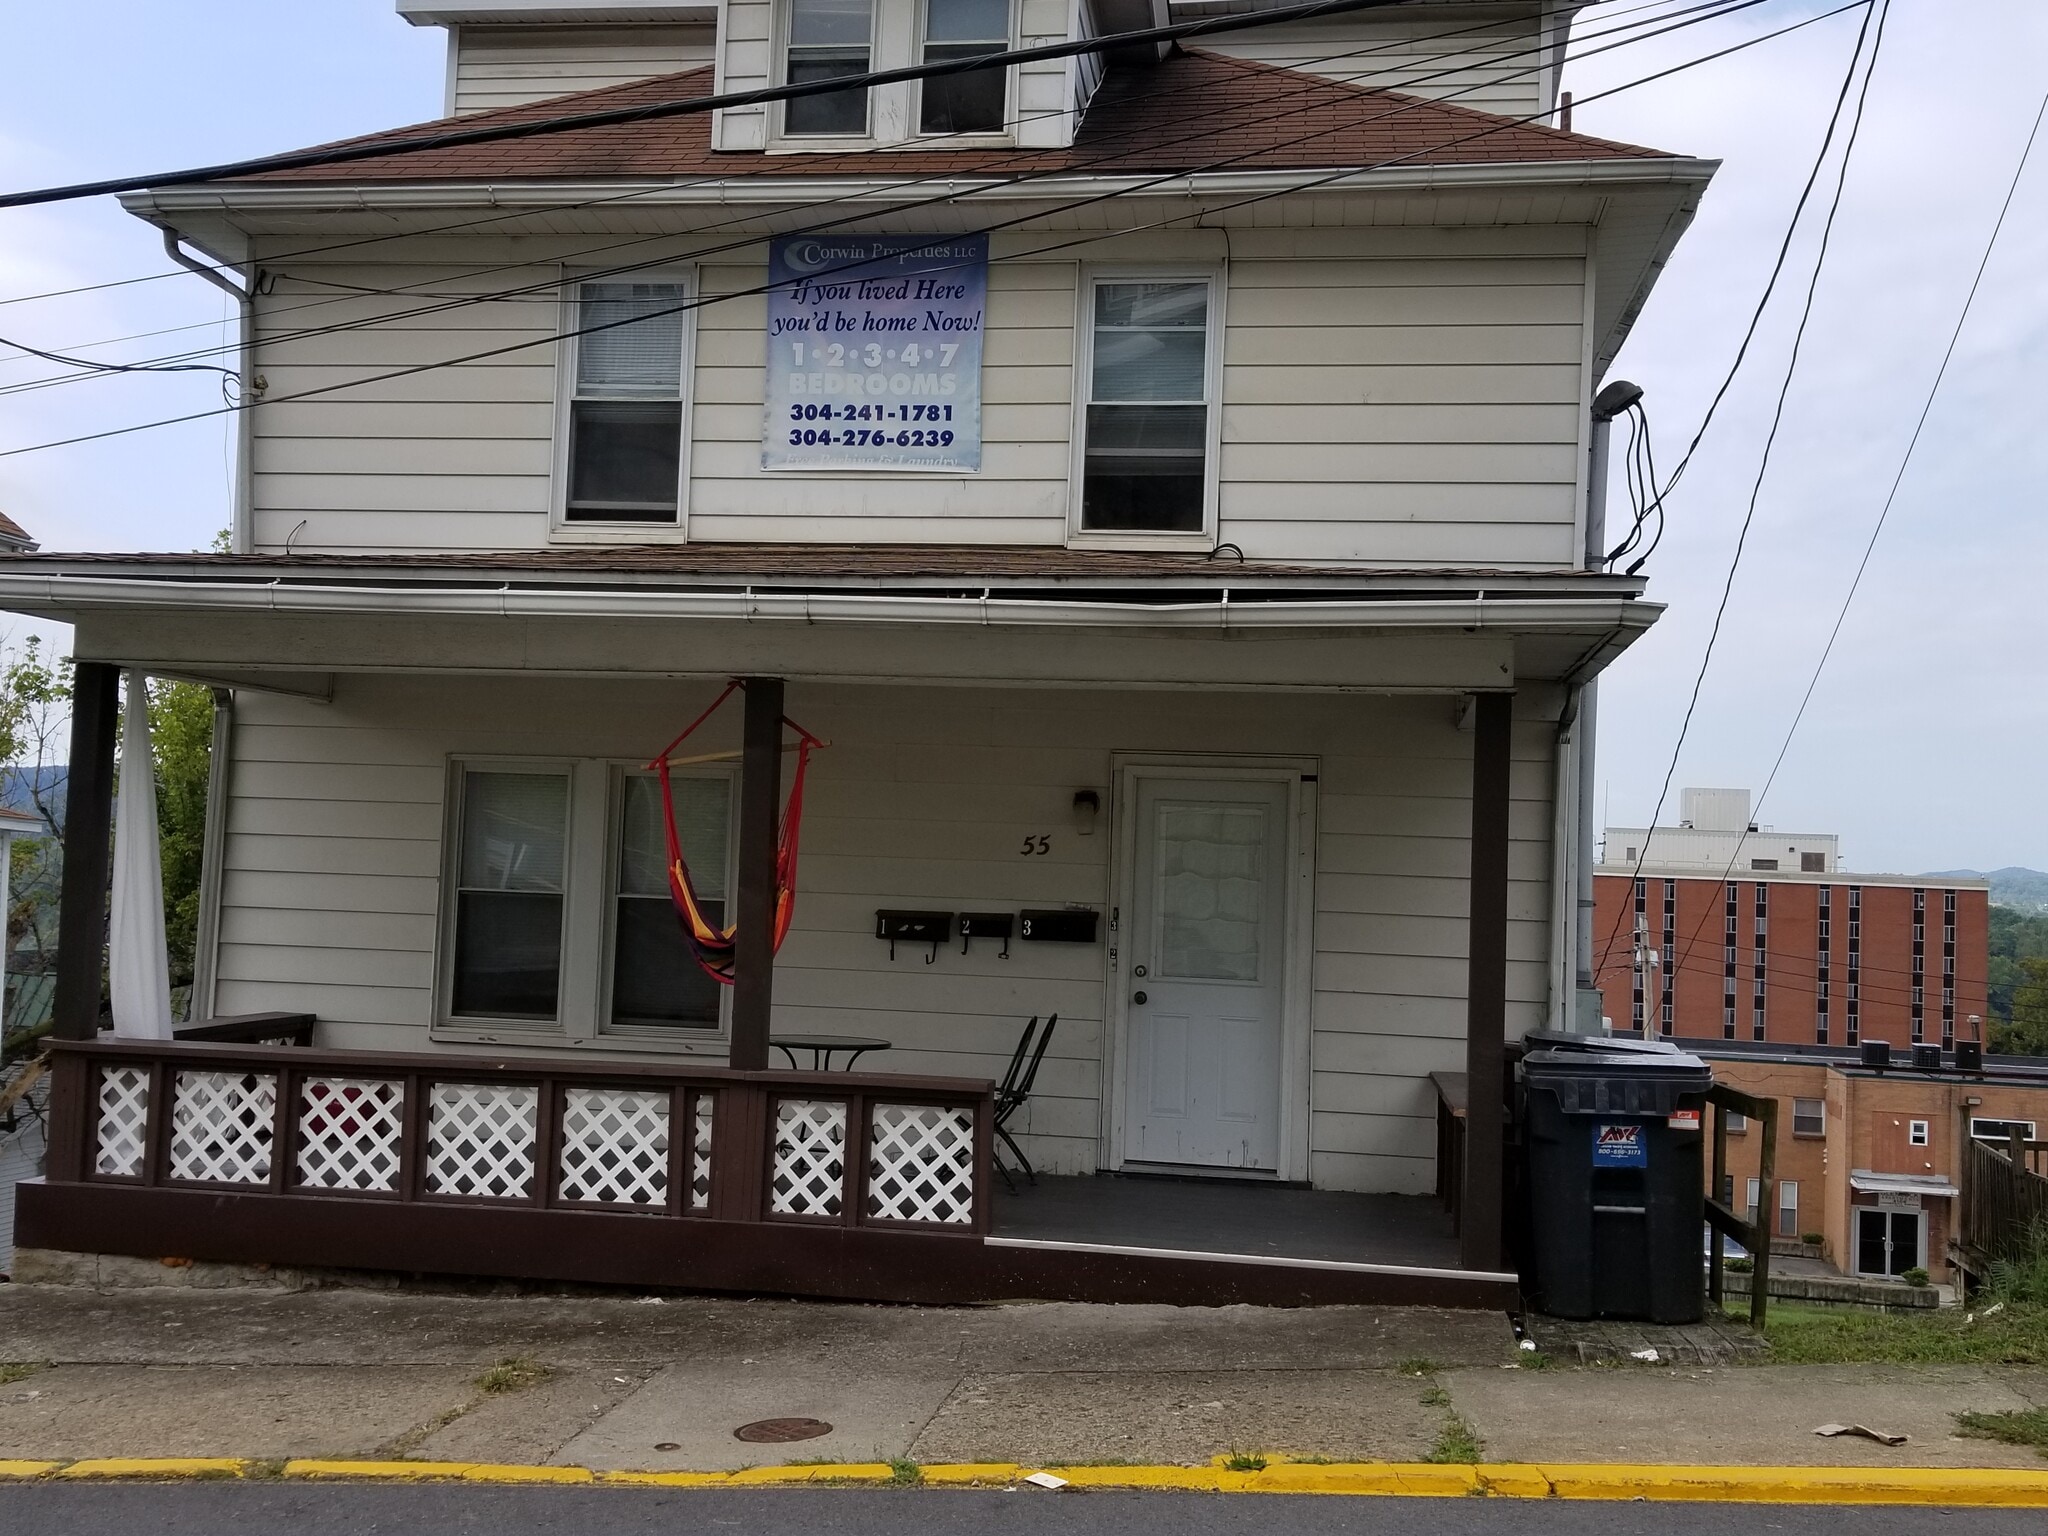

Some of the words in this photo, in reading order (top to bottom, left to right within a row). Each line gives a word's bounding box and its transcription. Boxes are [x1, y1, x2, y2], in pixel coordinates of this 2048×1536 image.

[803, 242, 865, 264] Corwin
[954, 247, 976, 258] LLC
[790, 279, 813, 305] If
[812, 284, 851, 305] you
[857, 279, 910, 300] lived
[913, 279, 966, 300] Here
[834, 310, 857, 332] be
[862, 310, 917, 332] home
[922, 309, 982, 332] Now!
[788, 372, 957, 396] BEDROOMS
[790, 404, 953, 422] 304-241-1781
[788, 429, 955, 447] 304-276-6239
[1020, 834, 1052, 856] 55
[880, 919, 887, 935] 1
[962, 919, 970, 934] 2
[1023, 919, 1032, 936] 3
[1111, 921, 1117, 931] 3
[1110, 950, 1117, 959] 2
